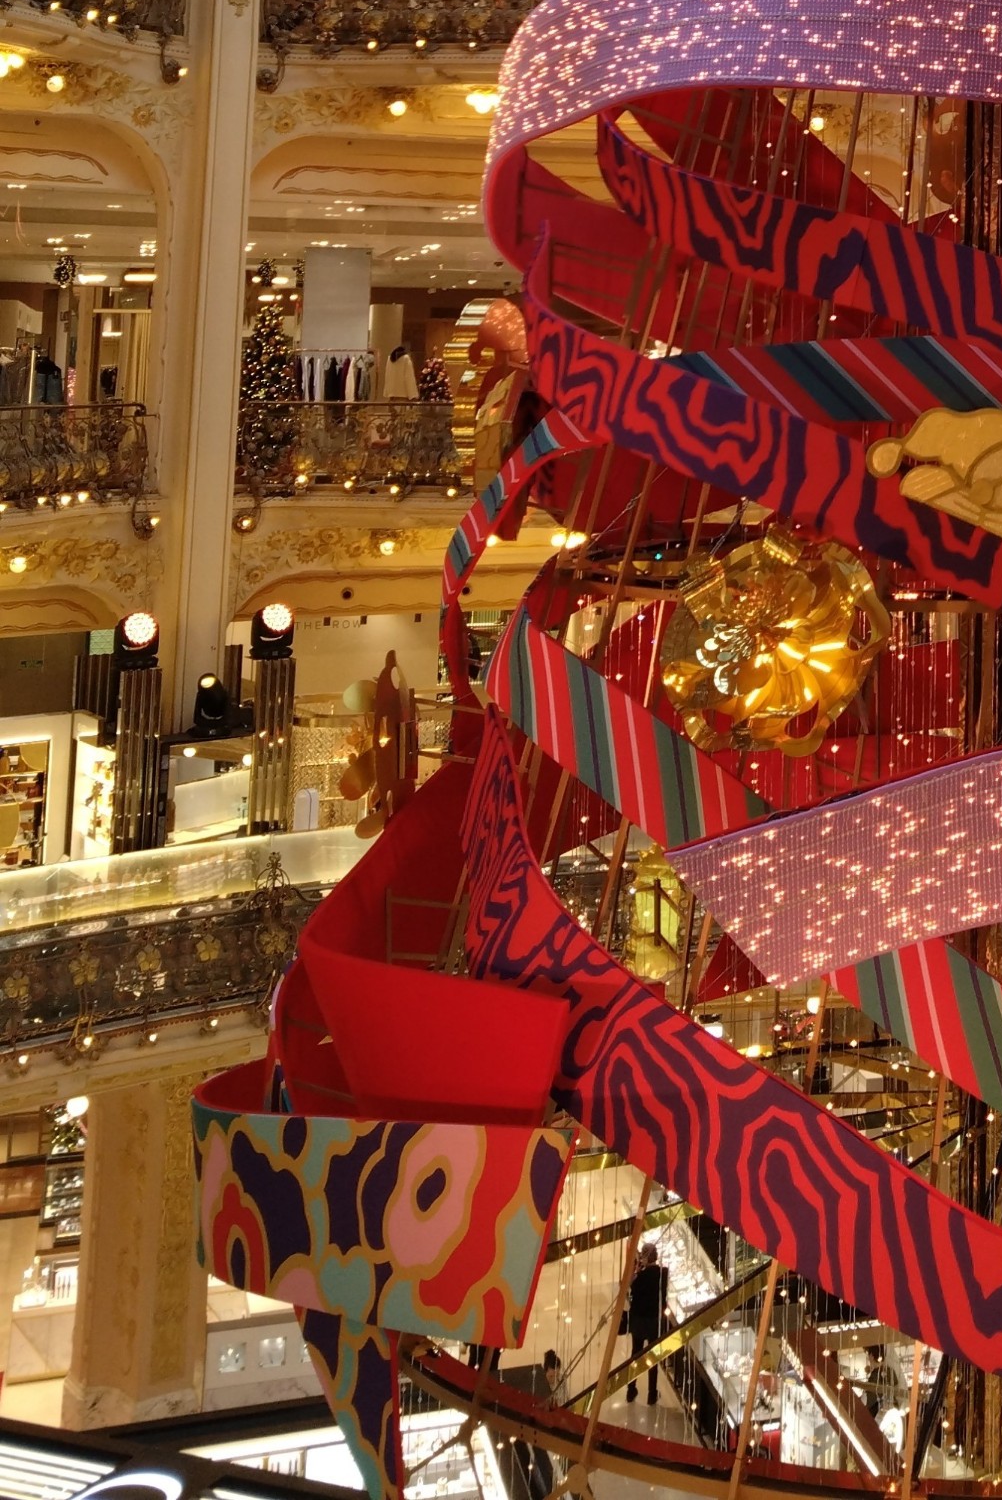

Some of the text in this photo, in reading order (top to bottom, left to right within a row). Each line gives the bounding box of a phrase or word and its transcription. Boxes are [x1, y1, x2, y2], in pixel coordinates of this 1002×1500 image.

[295, 619, 362, 631] THE ROW
[817, 1319, 881, 1334] ERMES
